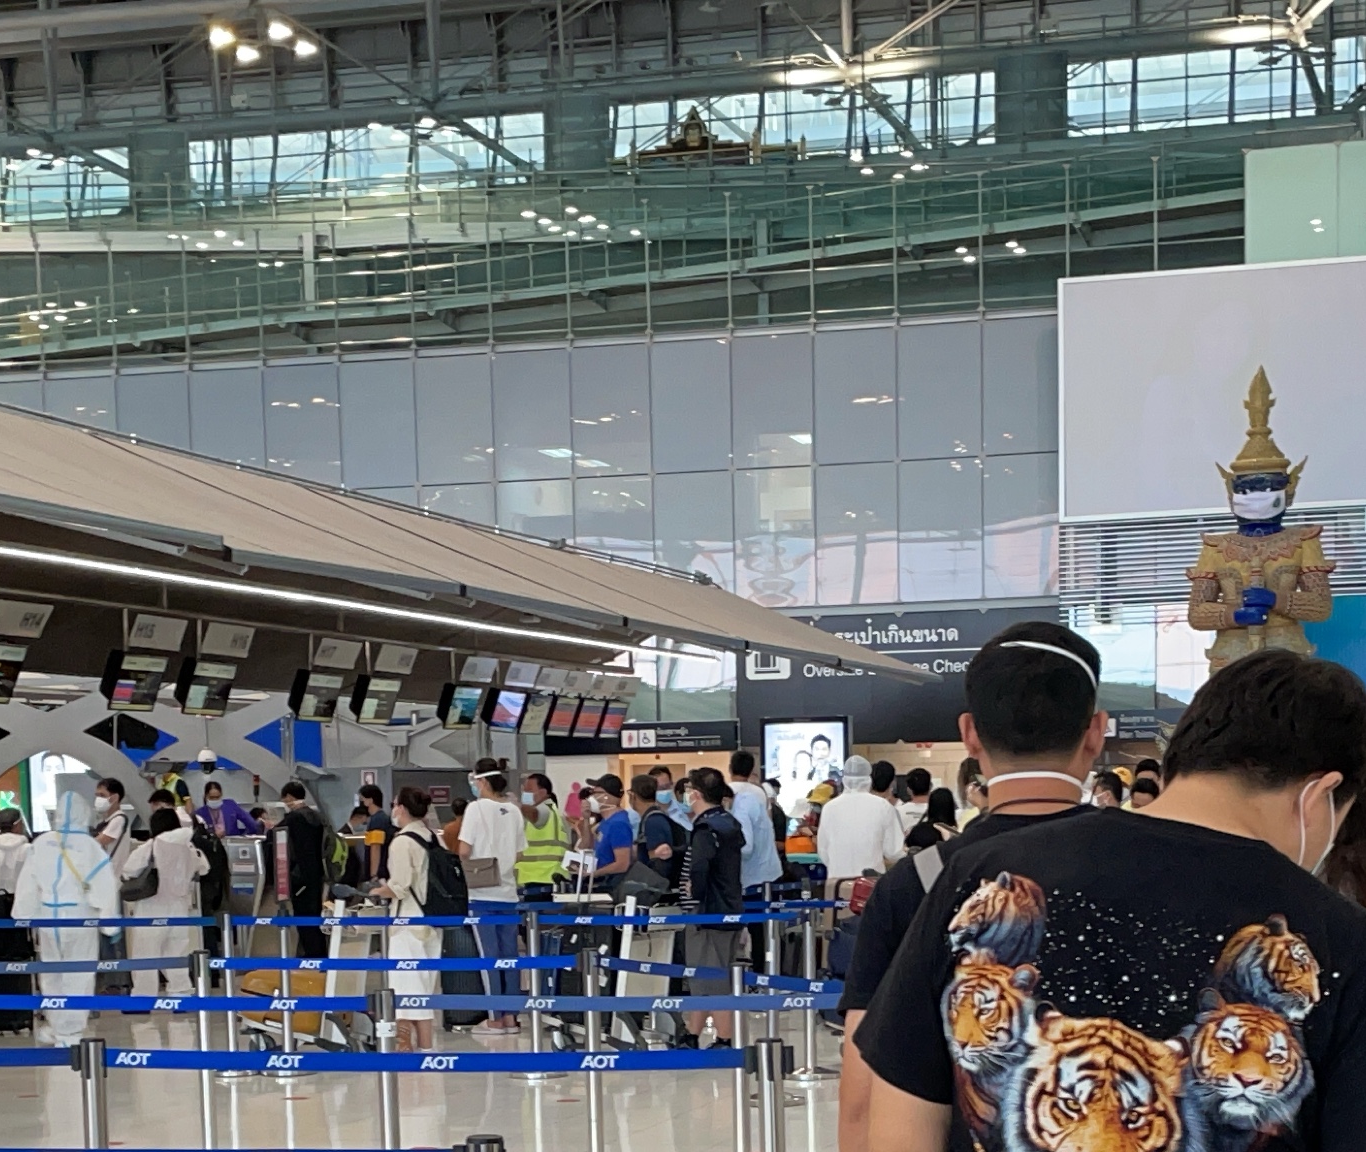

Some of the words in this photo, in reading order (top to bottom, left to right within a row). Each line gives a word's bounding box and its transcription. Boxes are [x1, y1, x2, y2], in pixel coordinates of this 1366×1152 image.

[575, 916, 594, 924] AOT
[649, 916, 667, 924] AOT
[723, 914, 742, 922] AOT
[5, 962, 28, 972] AOT
[97, 961, 119, 971] AOT
[209, 959, 226, 970] OT
[300, 959, 323, 970] AOT
[396, 960, 419, 970] AOT
[494, 959, 517, 970] AOT
[40, 998, 68, 1010] AOT
[153, 998, 183, 1010] AOT
[269, 999, 299, 1010] AOT
[399, 996, 430, 1008] AOT
[525, 998, 557, 1010] AOT
[651, 998, 684, 1010] AOT
[783, 997, 815, 1008] AOT
[115, 1052, 151, 1066] AOT
[266, 1054, 303, 1069] AOT
[420, 1055, 459, 1070] AOT
[580, 1055, 620, 1070] AOT
